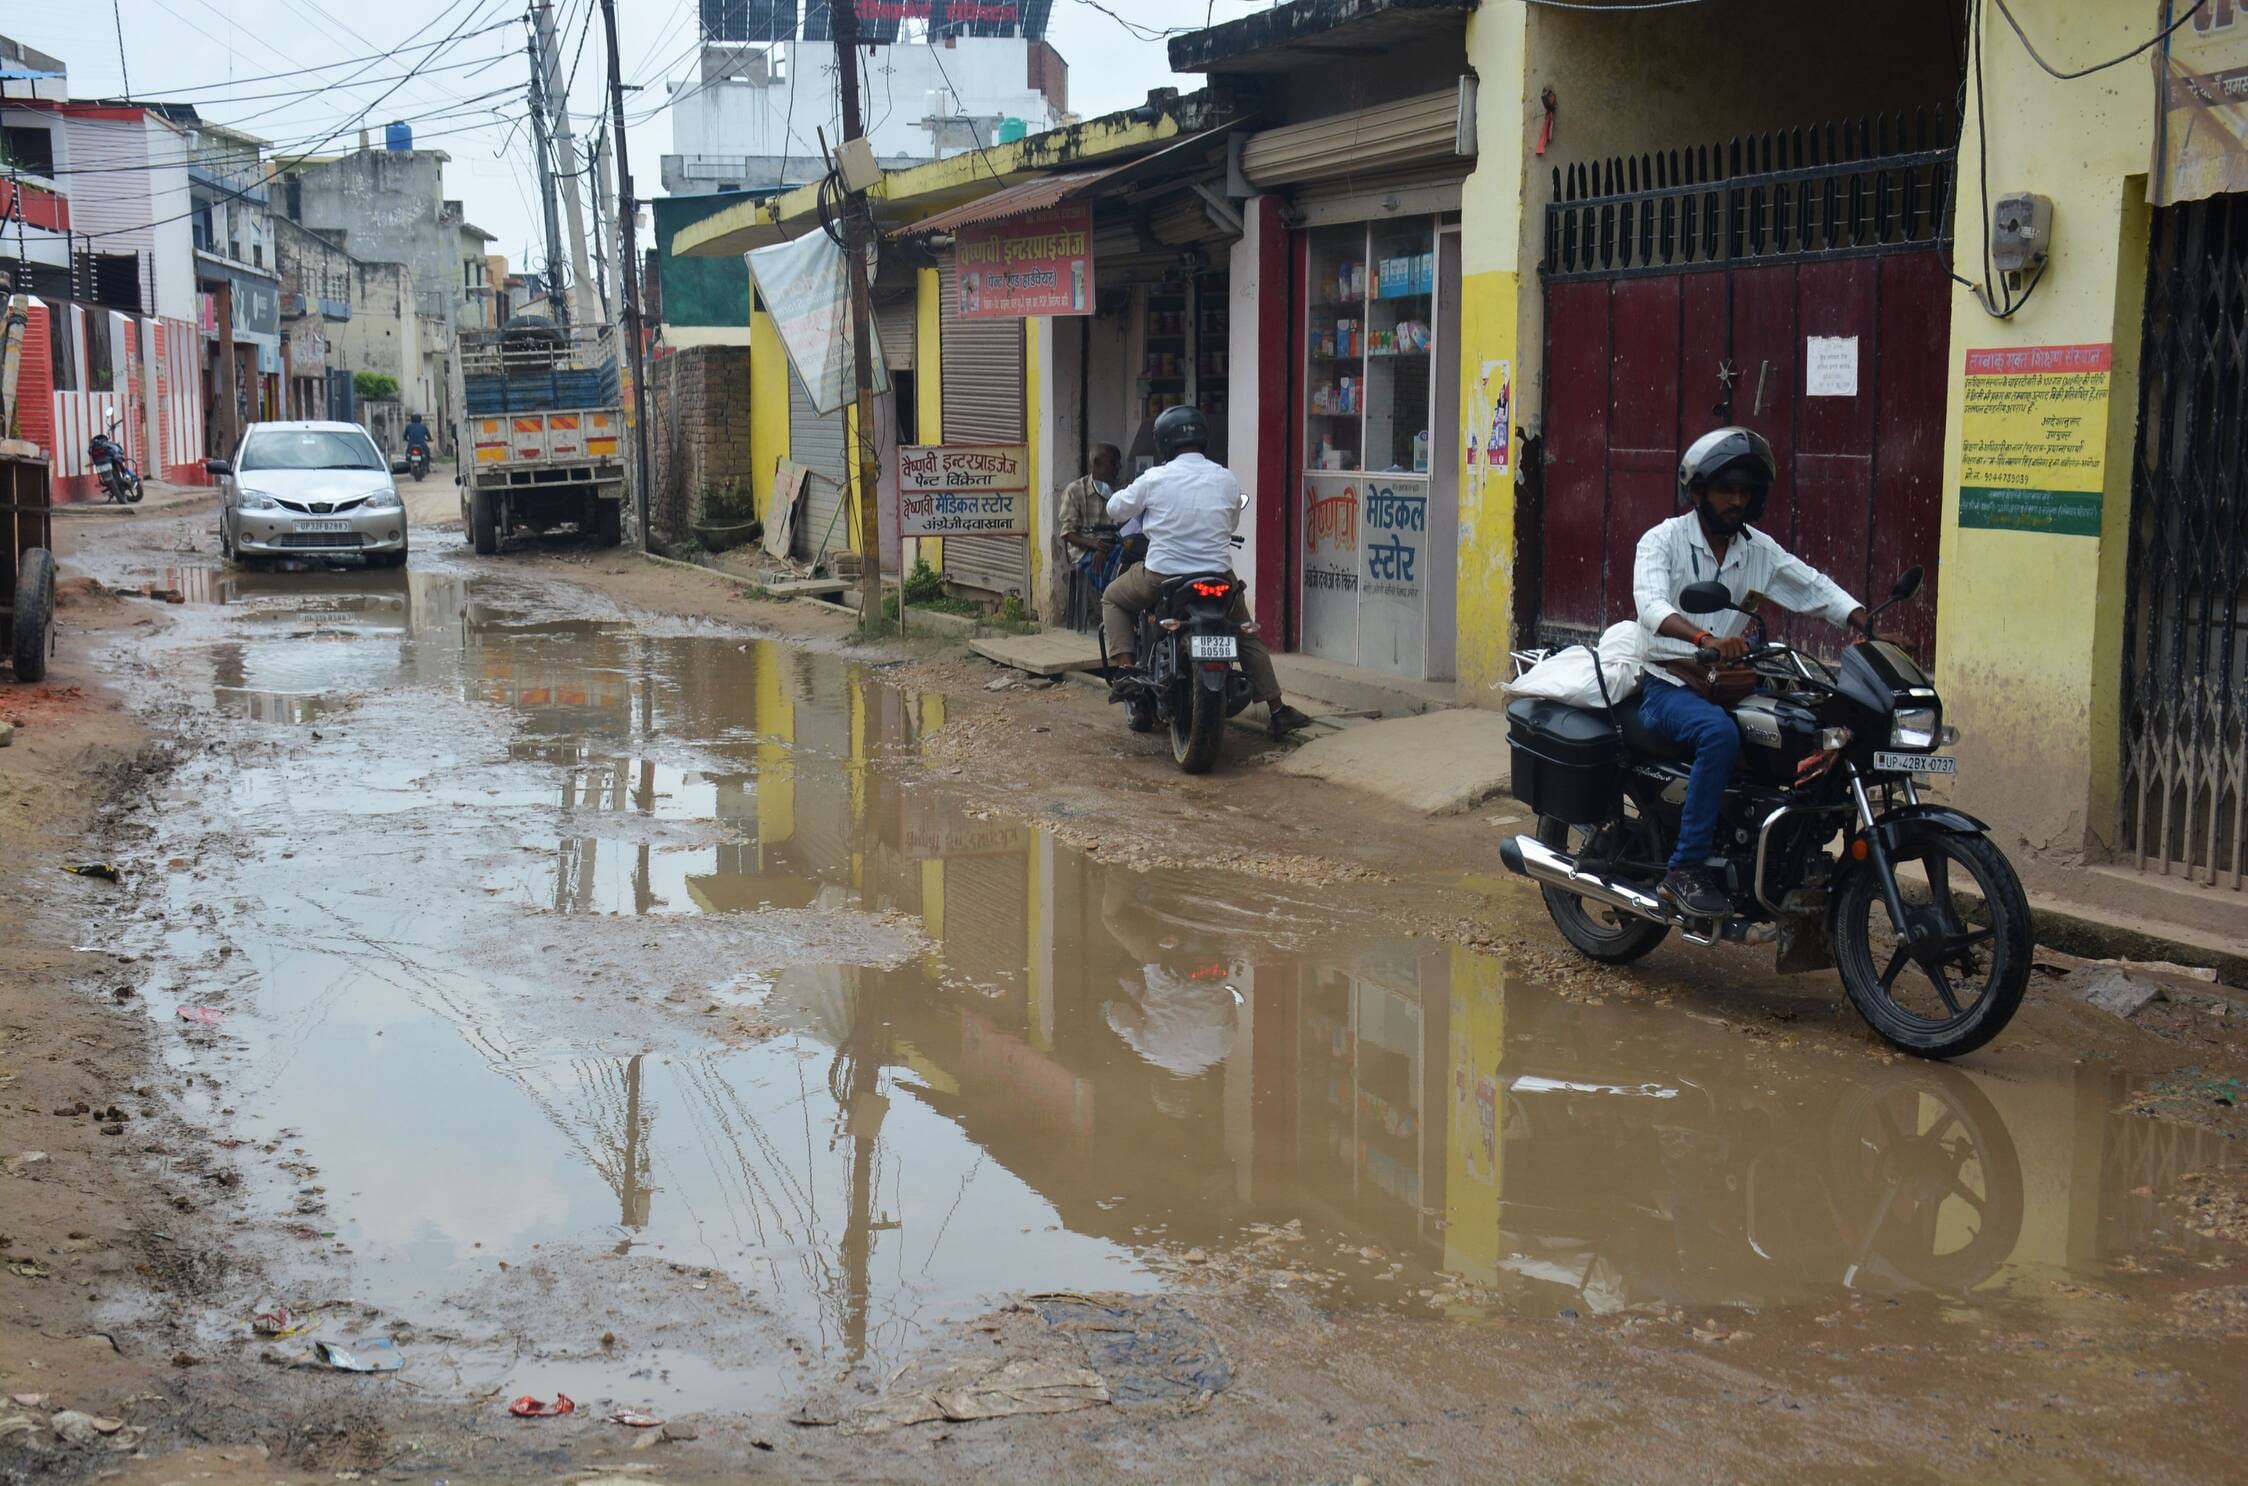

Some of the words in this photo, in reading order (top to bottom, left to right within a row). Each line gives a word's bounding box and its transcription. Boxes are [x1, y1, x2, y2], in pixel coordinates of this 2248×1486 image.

[902, 451, 938, 477] वैष्णवी
[942, 452, 1018, 475] इन्टरप्राइजेज
[913, 473, 941, 487] पेन्ट
[946, 471, 997, 486] विक्रेता
[903, 494, 934, 520] वैष्णवी
[935, 492, 979, 514] मेडिकल
[980, 492, 1014, 513] स्टोर
[1366, 483, 1428, 531] मेडिकल
[1368, 533, 1416, 581] स्टोर
[1200, 636, 1231, 647] UP32J
[1886, 756, 1899, 768] UP
[1930, 758, 1954, 771] 0737
